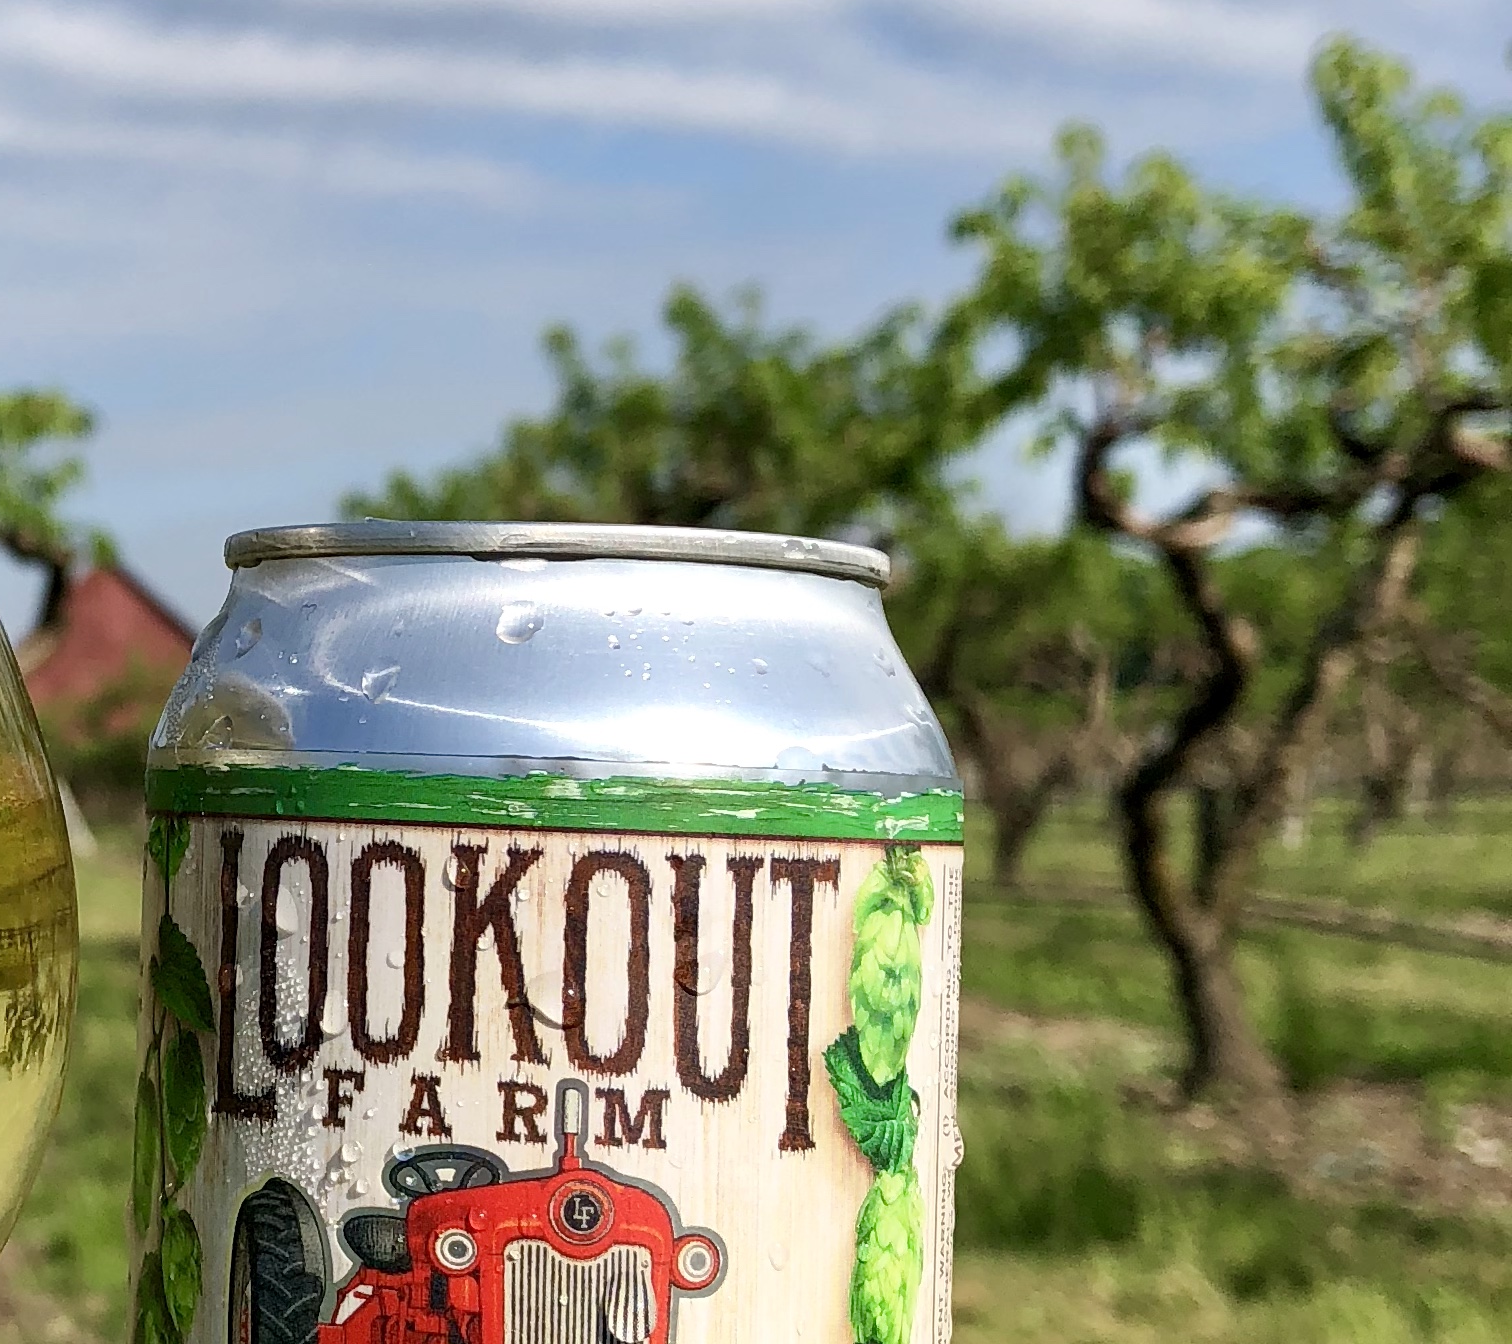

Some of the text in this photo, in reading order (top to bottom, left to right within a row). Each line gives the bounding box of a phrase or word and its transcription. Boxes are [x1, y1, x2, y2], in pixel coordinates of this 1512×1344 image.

[212, 828, 841, 1157] LOOKOUT
[943, 968, 952, 1099] ACCORDING
[321, 1068, 671, 1150] FARM
